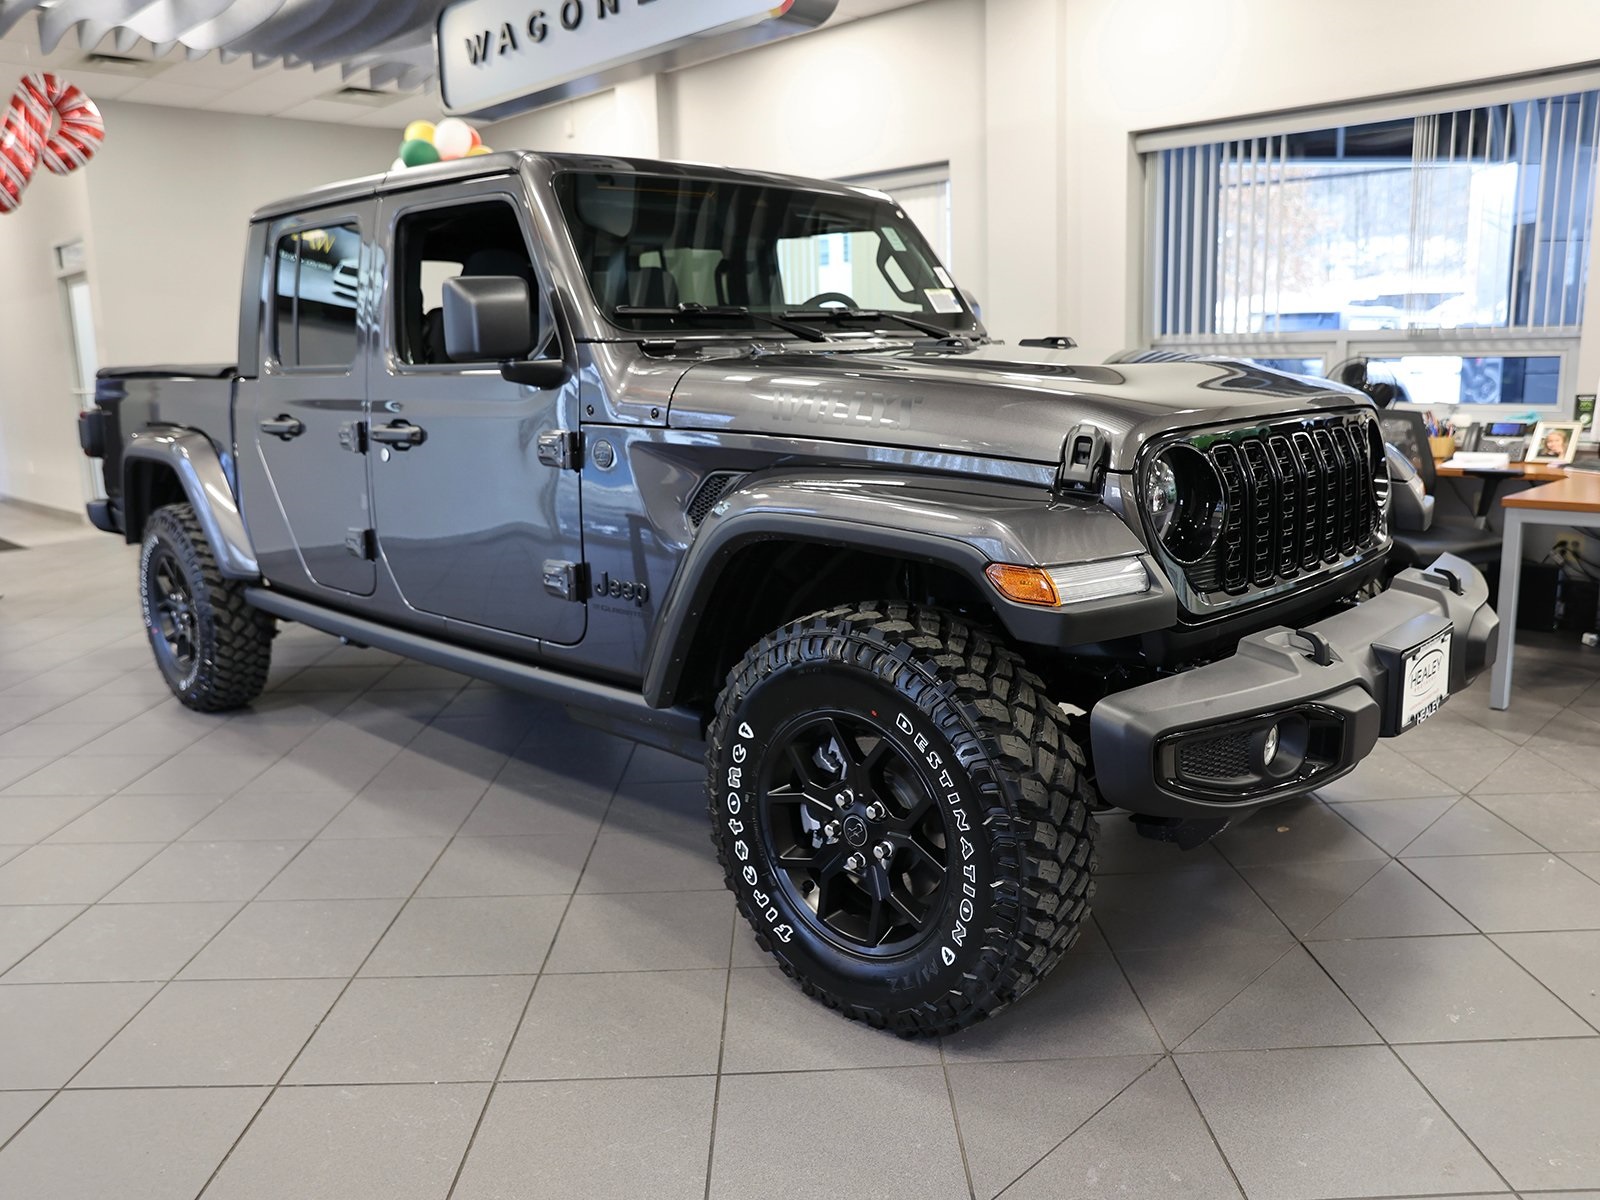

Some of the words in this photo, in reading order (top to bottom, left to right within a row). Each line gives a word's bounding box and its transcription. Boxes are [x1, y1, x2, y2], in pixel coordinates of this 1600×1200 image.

[464, 0, 659, 66] WAGON
[594, 570, 649, 608] Jeep
[1410, 656, 1443, 689] HEALEY
[727, 743, 793, 944] Firestone
[895, 712, 976, 947] DESTINATION
